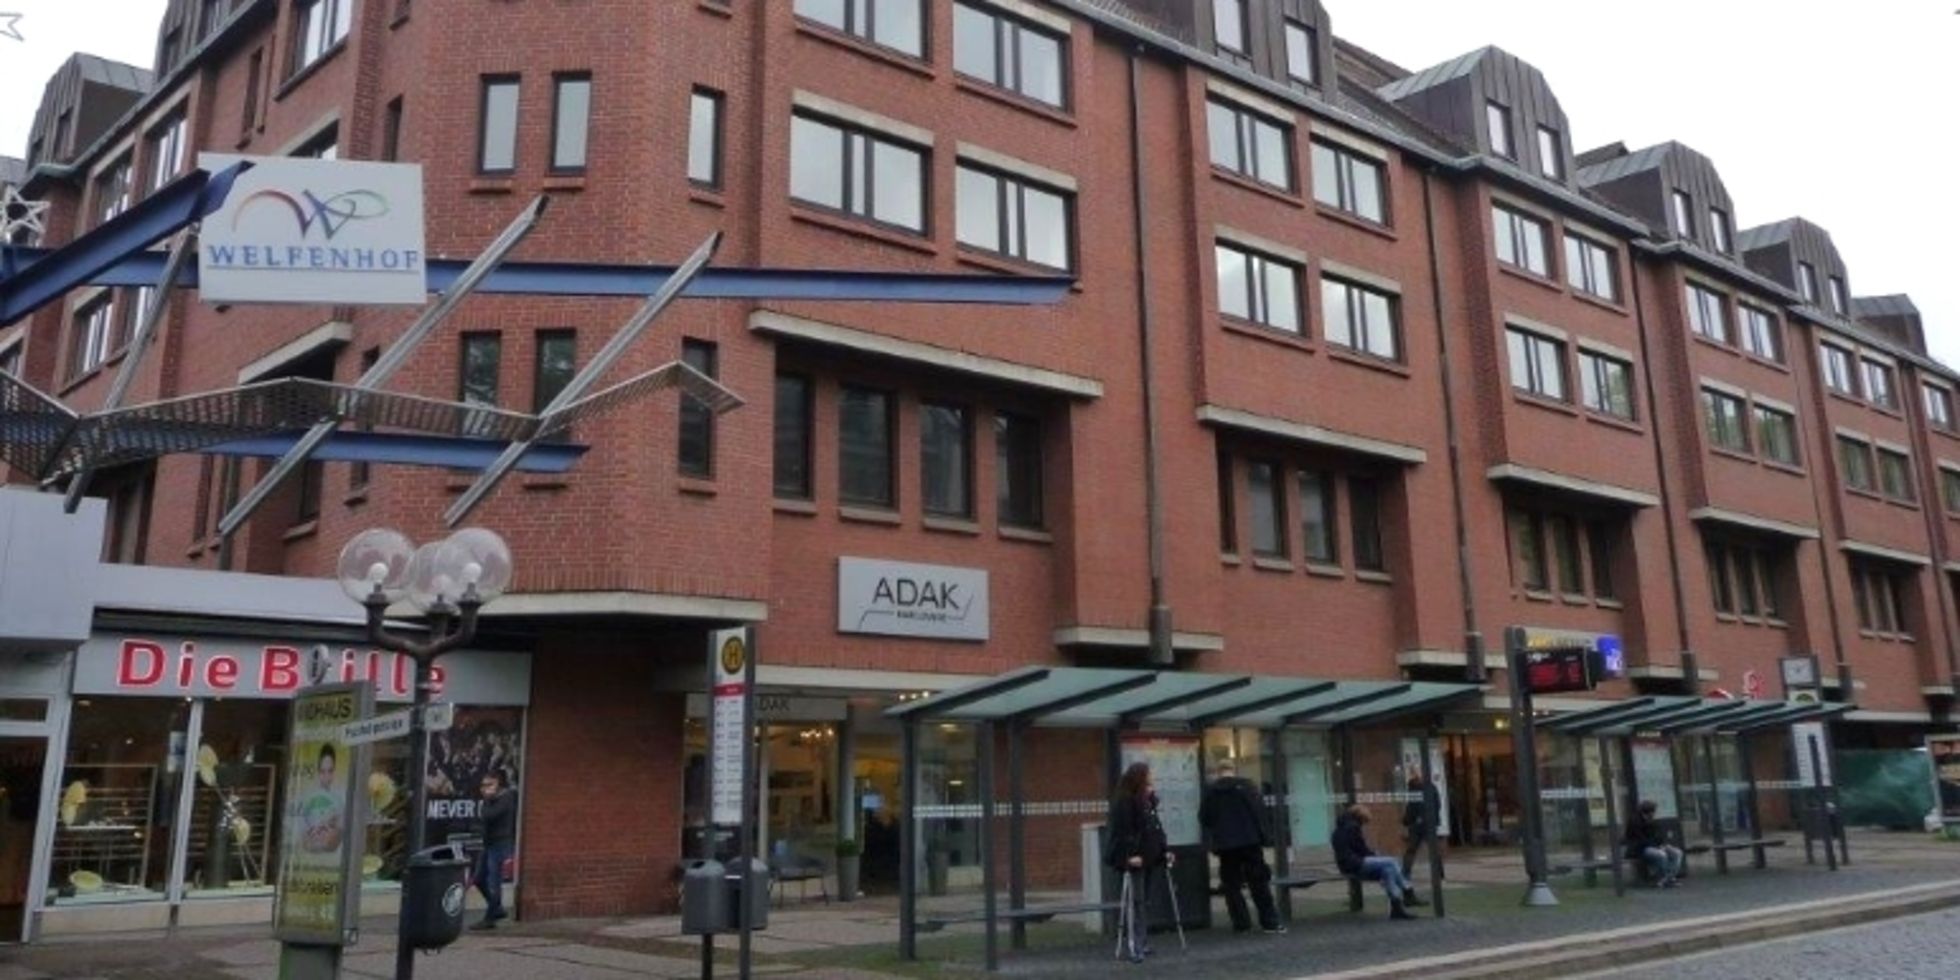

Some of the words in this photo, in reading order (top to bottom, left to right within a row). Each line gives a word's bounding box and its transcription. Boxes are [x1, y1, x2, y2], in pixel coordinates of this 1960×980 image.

[208, 245, 419, 268] WELFENHOF
[872, 577, 959, 609] ADAK
[117, 639, 239, 689] Die
[259, 646, 446, 697] Bille
[427, 799, 475, 819] NEVER
